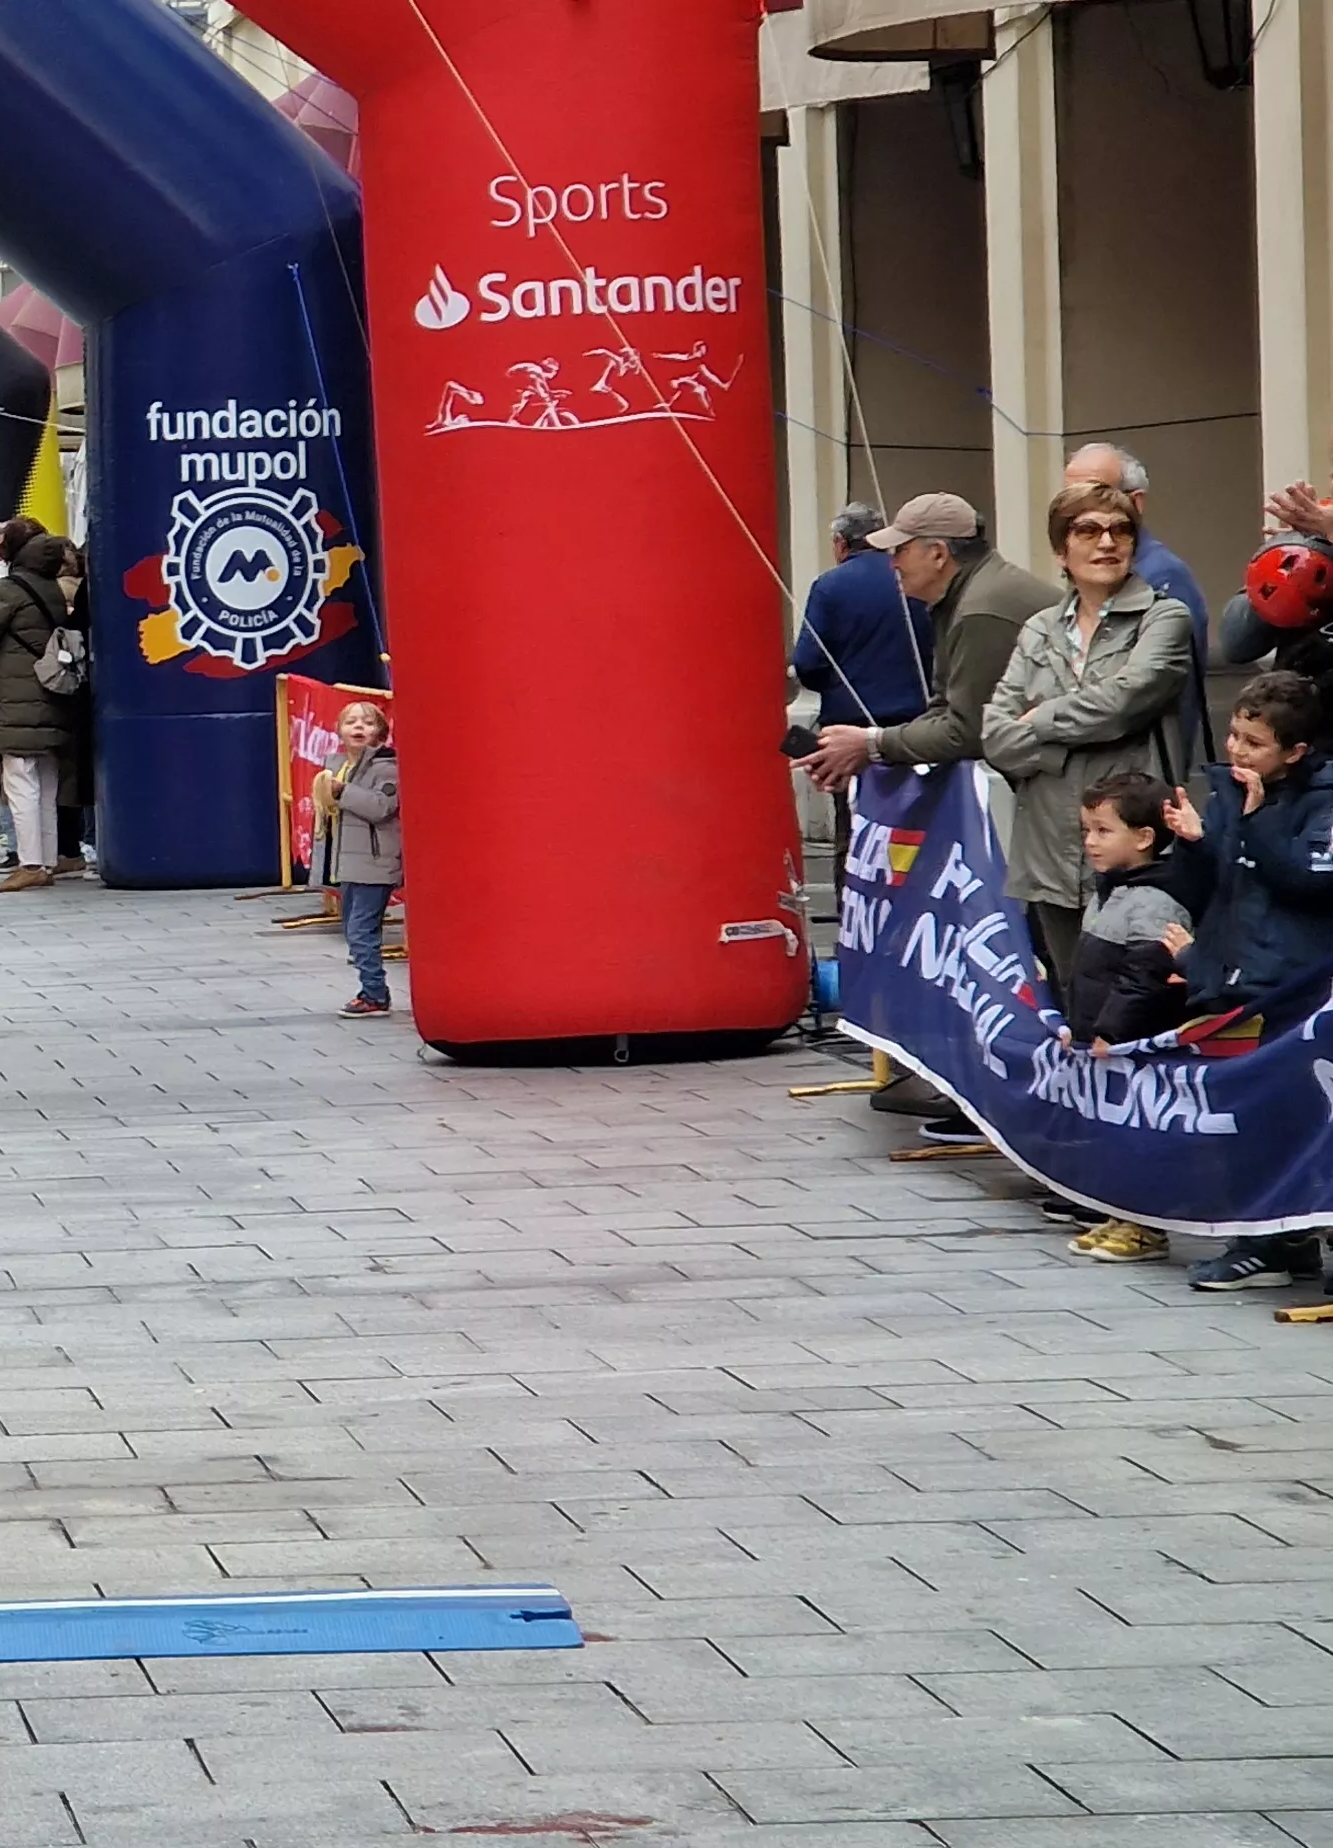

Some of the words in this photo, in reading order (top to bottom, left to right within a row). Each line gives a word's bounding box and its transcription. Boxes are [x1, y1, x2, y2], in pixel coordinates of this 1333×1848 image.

[489, 173, 669, 238] Sports
[478, 265, 742, 322] Santander
[146, 398, 342, 441] fundación
[180, 440, 307, 488] mupol
[216, 517, 230, 528] de
[230, 511, 243, 521] la
[292, 549, 302, 563] de
[293, 565, 304, 576] la
[219, 609, 279, 628] POLICÍA
